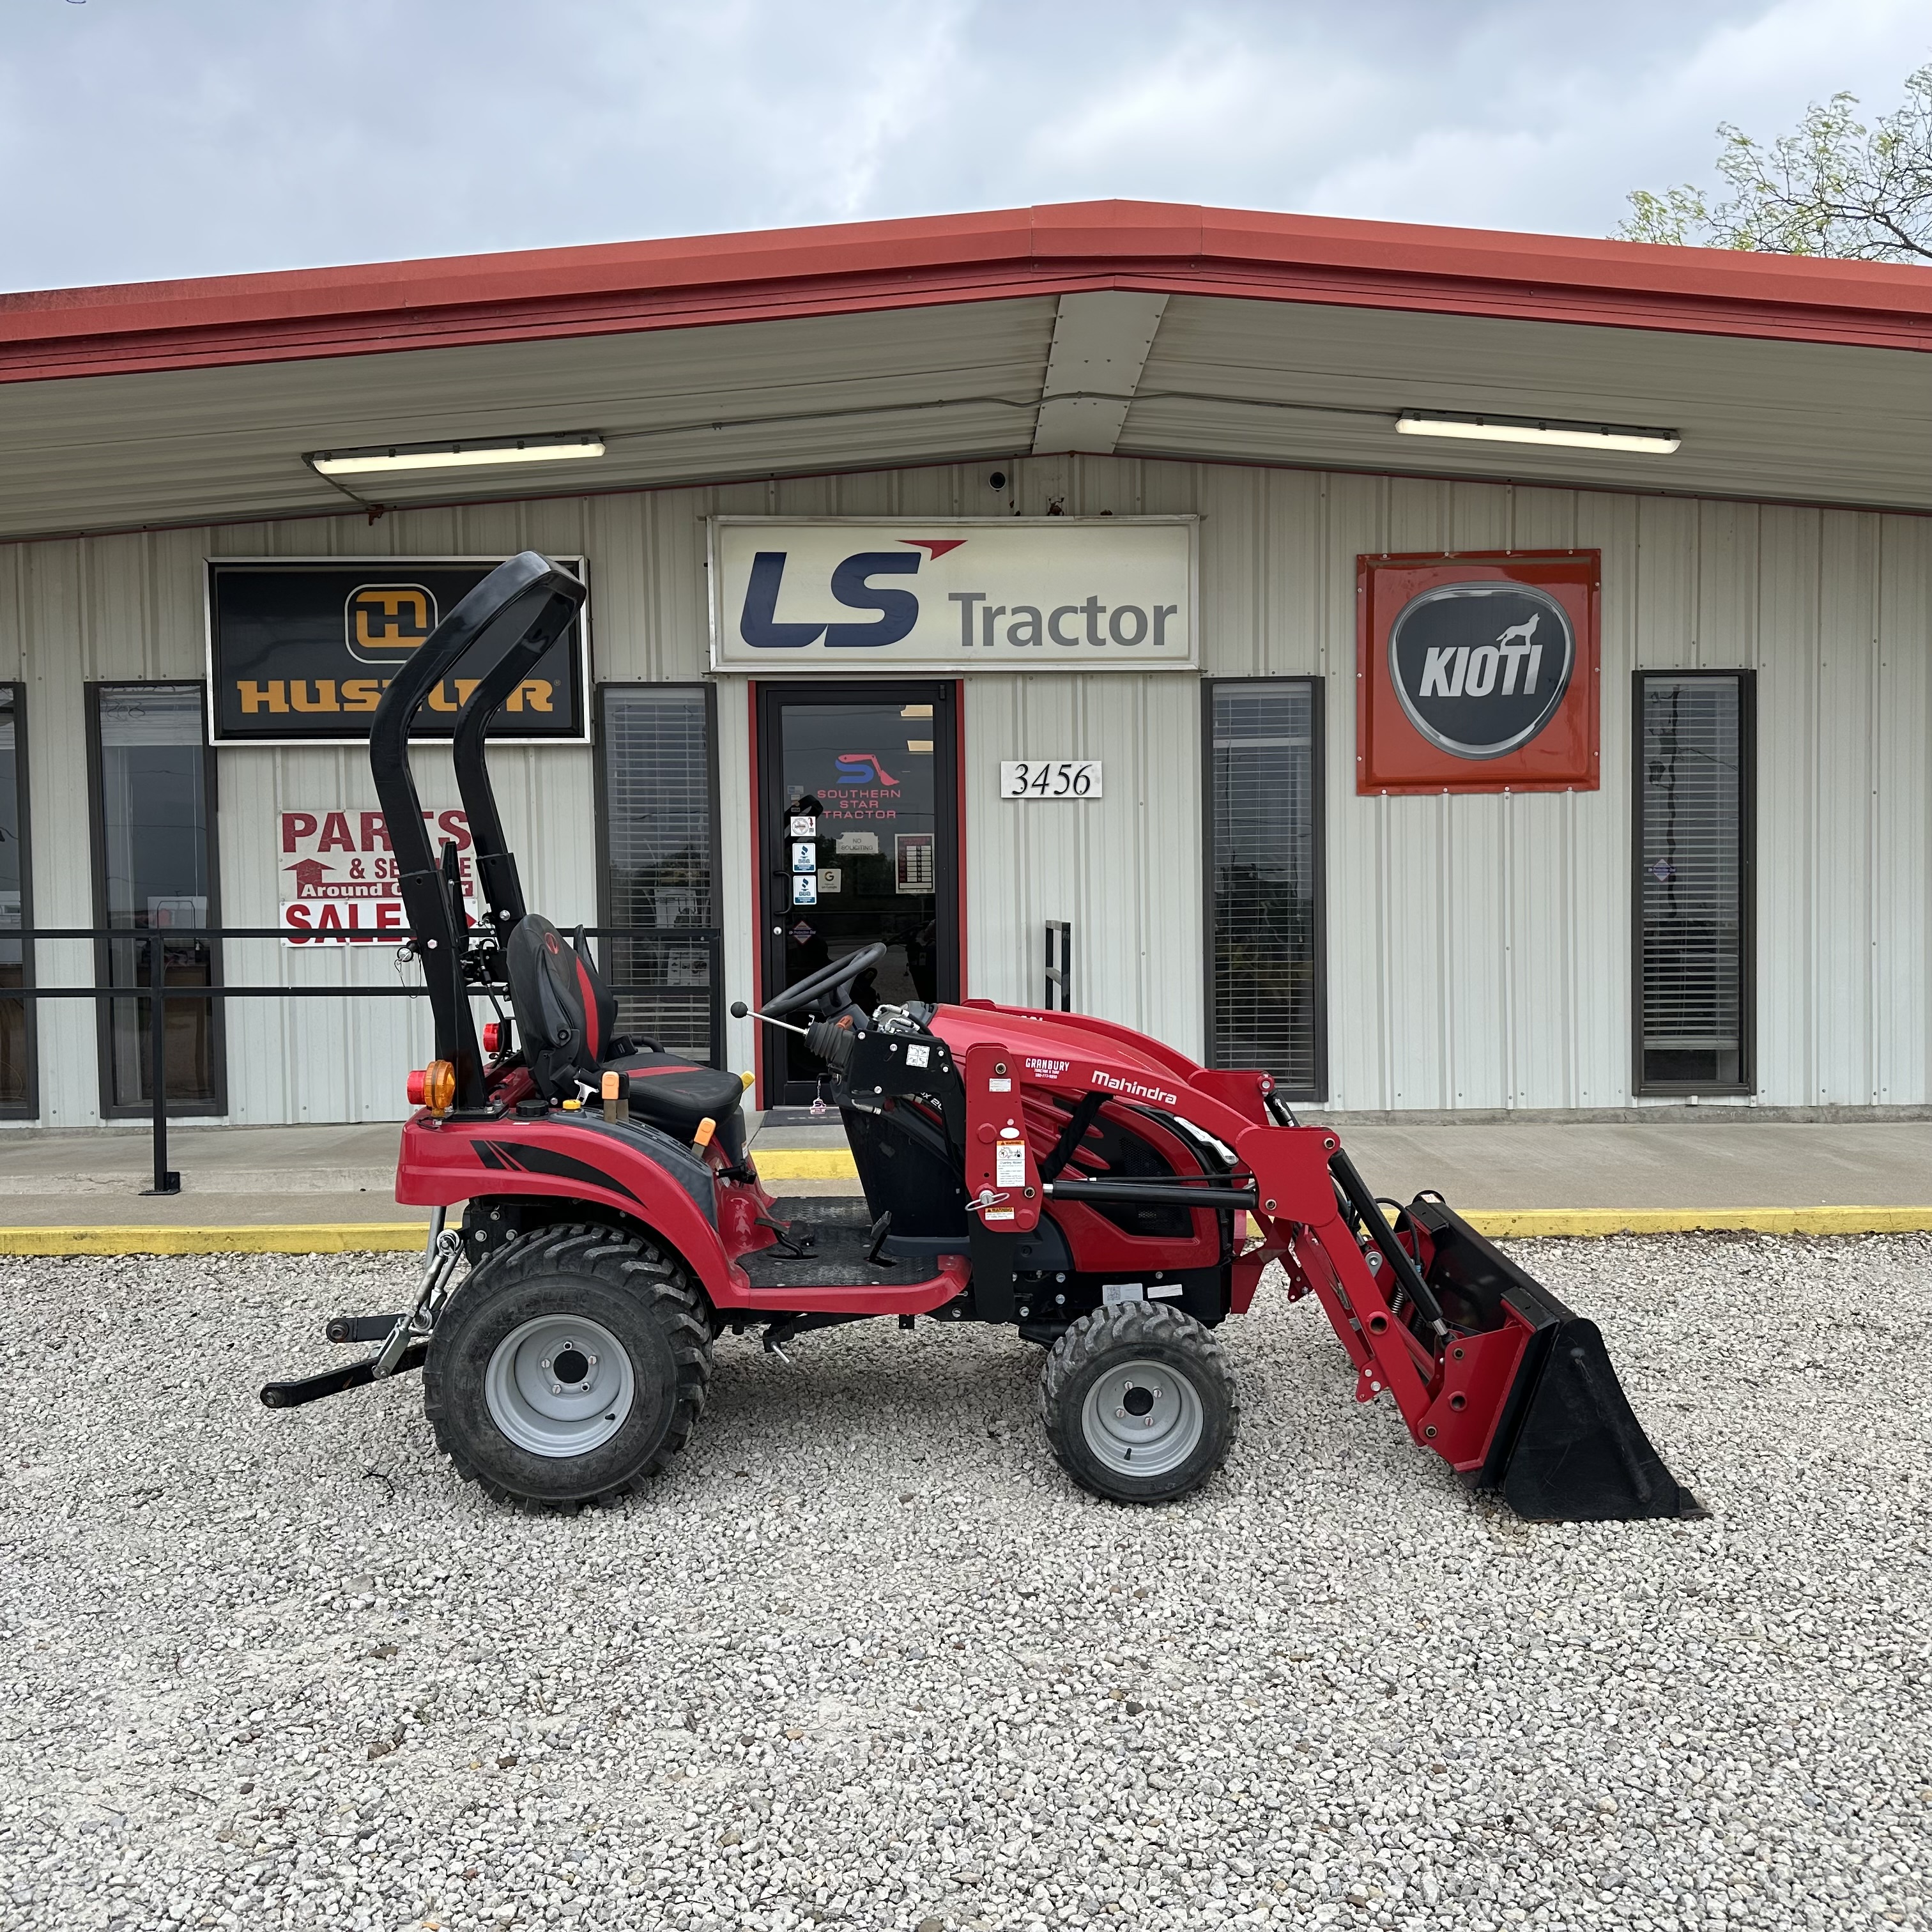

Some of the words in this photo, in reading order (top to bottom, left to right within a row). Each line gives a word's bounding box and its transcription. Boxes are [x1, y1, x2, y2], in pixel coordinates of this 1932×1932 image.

[740, 552, 921, 648] LS
[948, 592, 1177, 647] Tractor
[1418, 644, 1543, 697] KIOTI
[1012, 763, 1093, 795] 3456
[817, 790, 901, 798] SOUTHERN
[839, 800, 878, 808] STAR
[823, 810, 896, 818] TRACTOR
[282, 810, 471, 853] PARS
[349, 858, 365, 879] &
[301, 883, 382, 897] Around
[1025, 1057, 1070, 1071] GRANBURY
[1091, 1070, 1177, 1105] Mahindra
